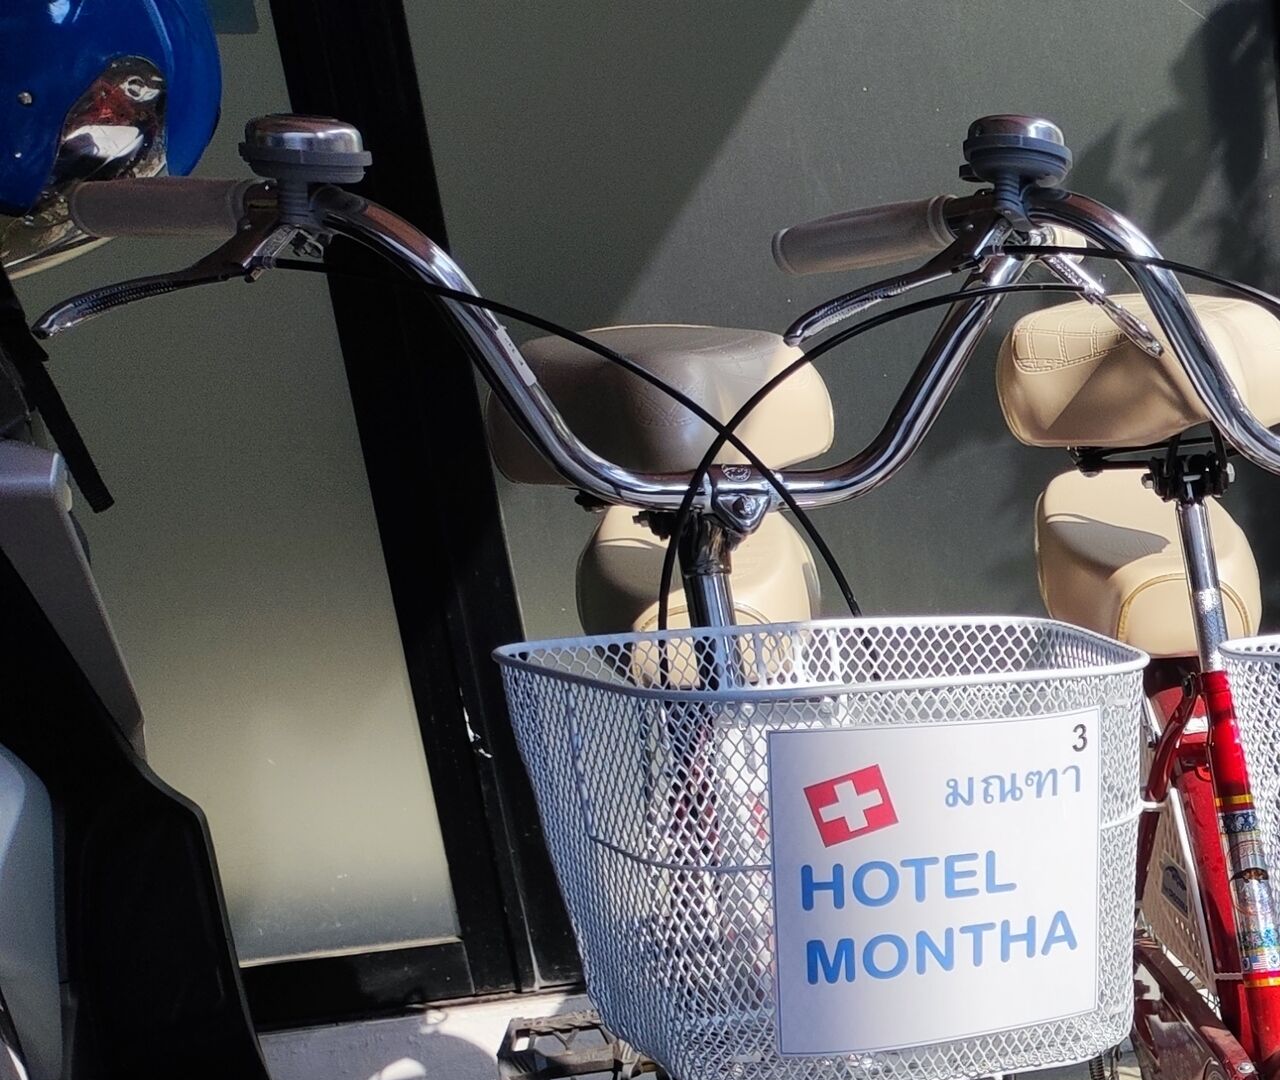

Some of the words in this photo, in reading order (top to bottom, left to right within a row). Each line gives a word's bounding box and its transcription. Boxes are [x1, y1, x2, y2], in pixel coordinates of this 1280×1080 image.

[1071, 723, 1088, 752] 3
[944, 763, 1082, 808] มณฑา
[800, 850, 1017, 912] HOTEL
[806, 910, 1079, 986] MONTHA
